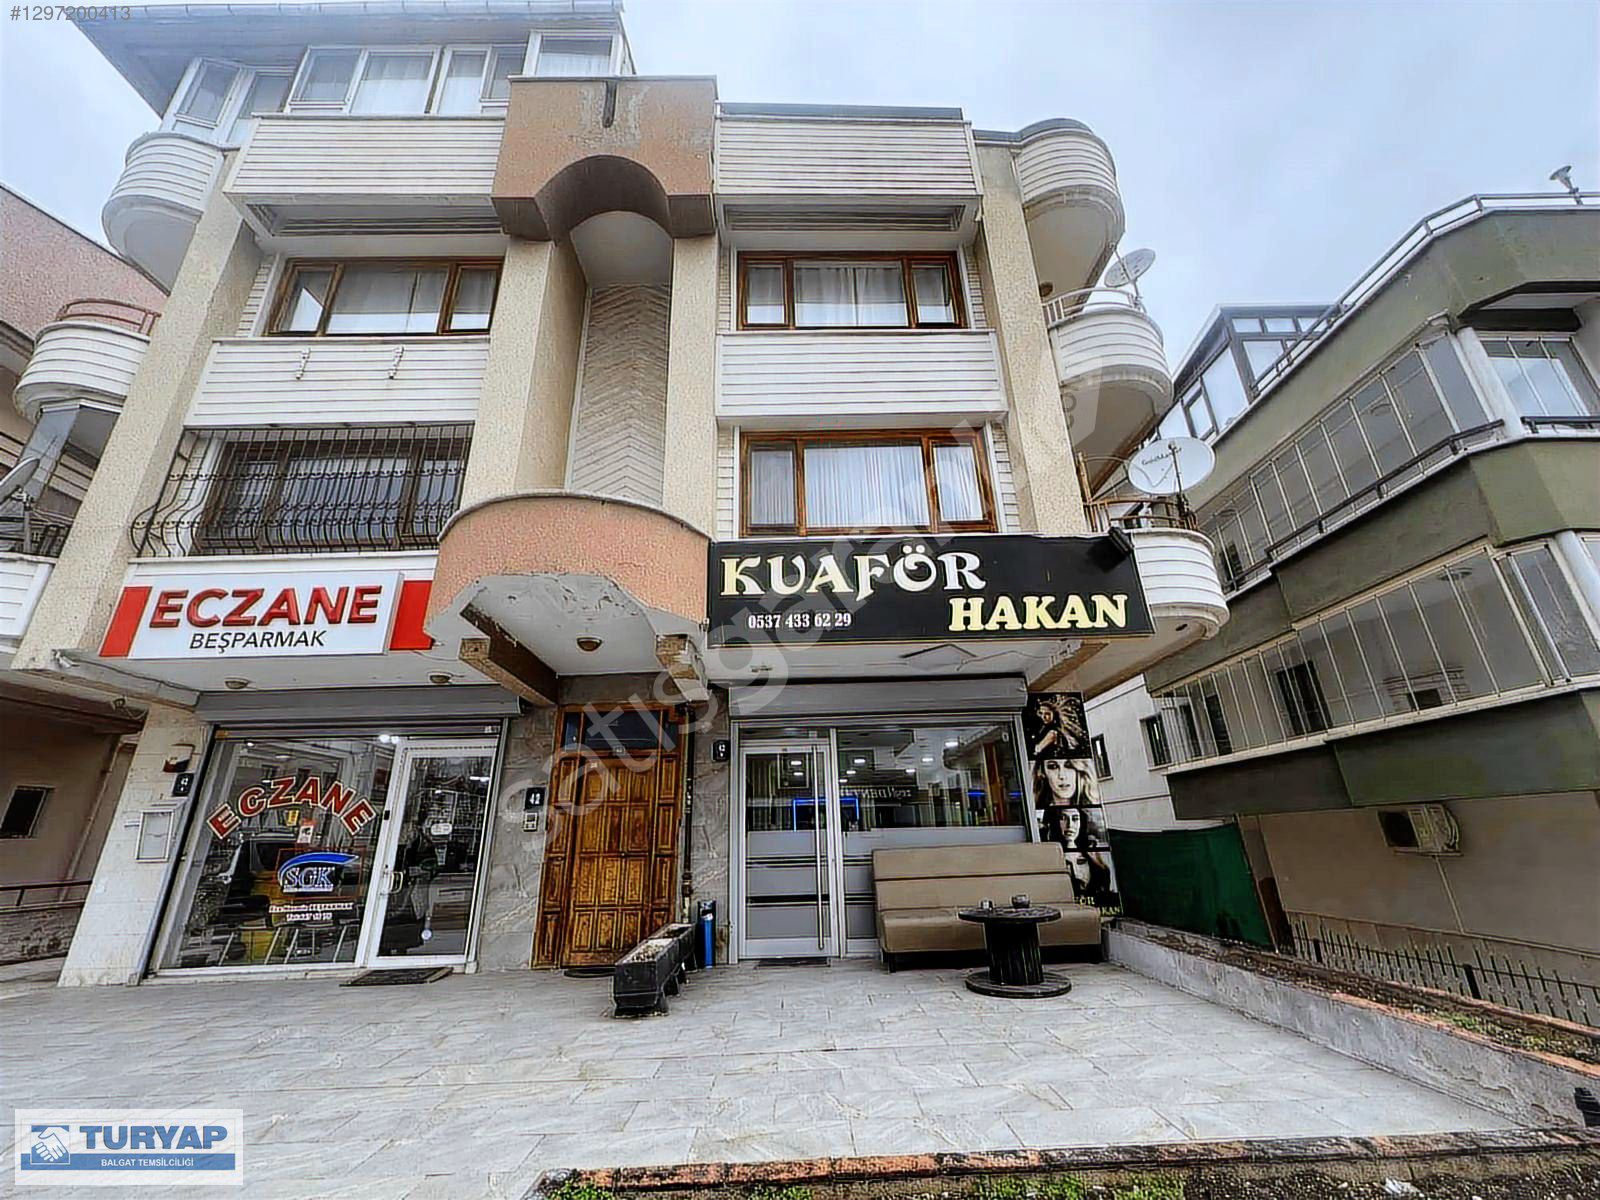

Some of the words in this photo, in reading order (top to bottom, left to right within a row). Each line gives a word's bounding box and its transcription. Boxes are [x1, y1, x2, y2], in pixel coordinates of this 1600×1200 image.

[720, 545, 987, 601] KUAFÖR
[149, 586, 382, 628] ECZANE
[748, 614, 781, 629] 0537
[785, 613, 810, 629] 433
[814, 613, 831, 628] 62
[834, 612, 852, 627] 29
[948, 594, 1128, 632] HAKAN
[189, 630, 327, 653] BEŞPARMAK
[206, 777, 377, 840] ECZANE
